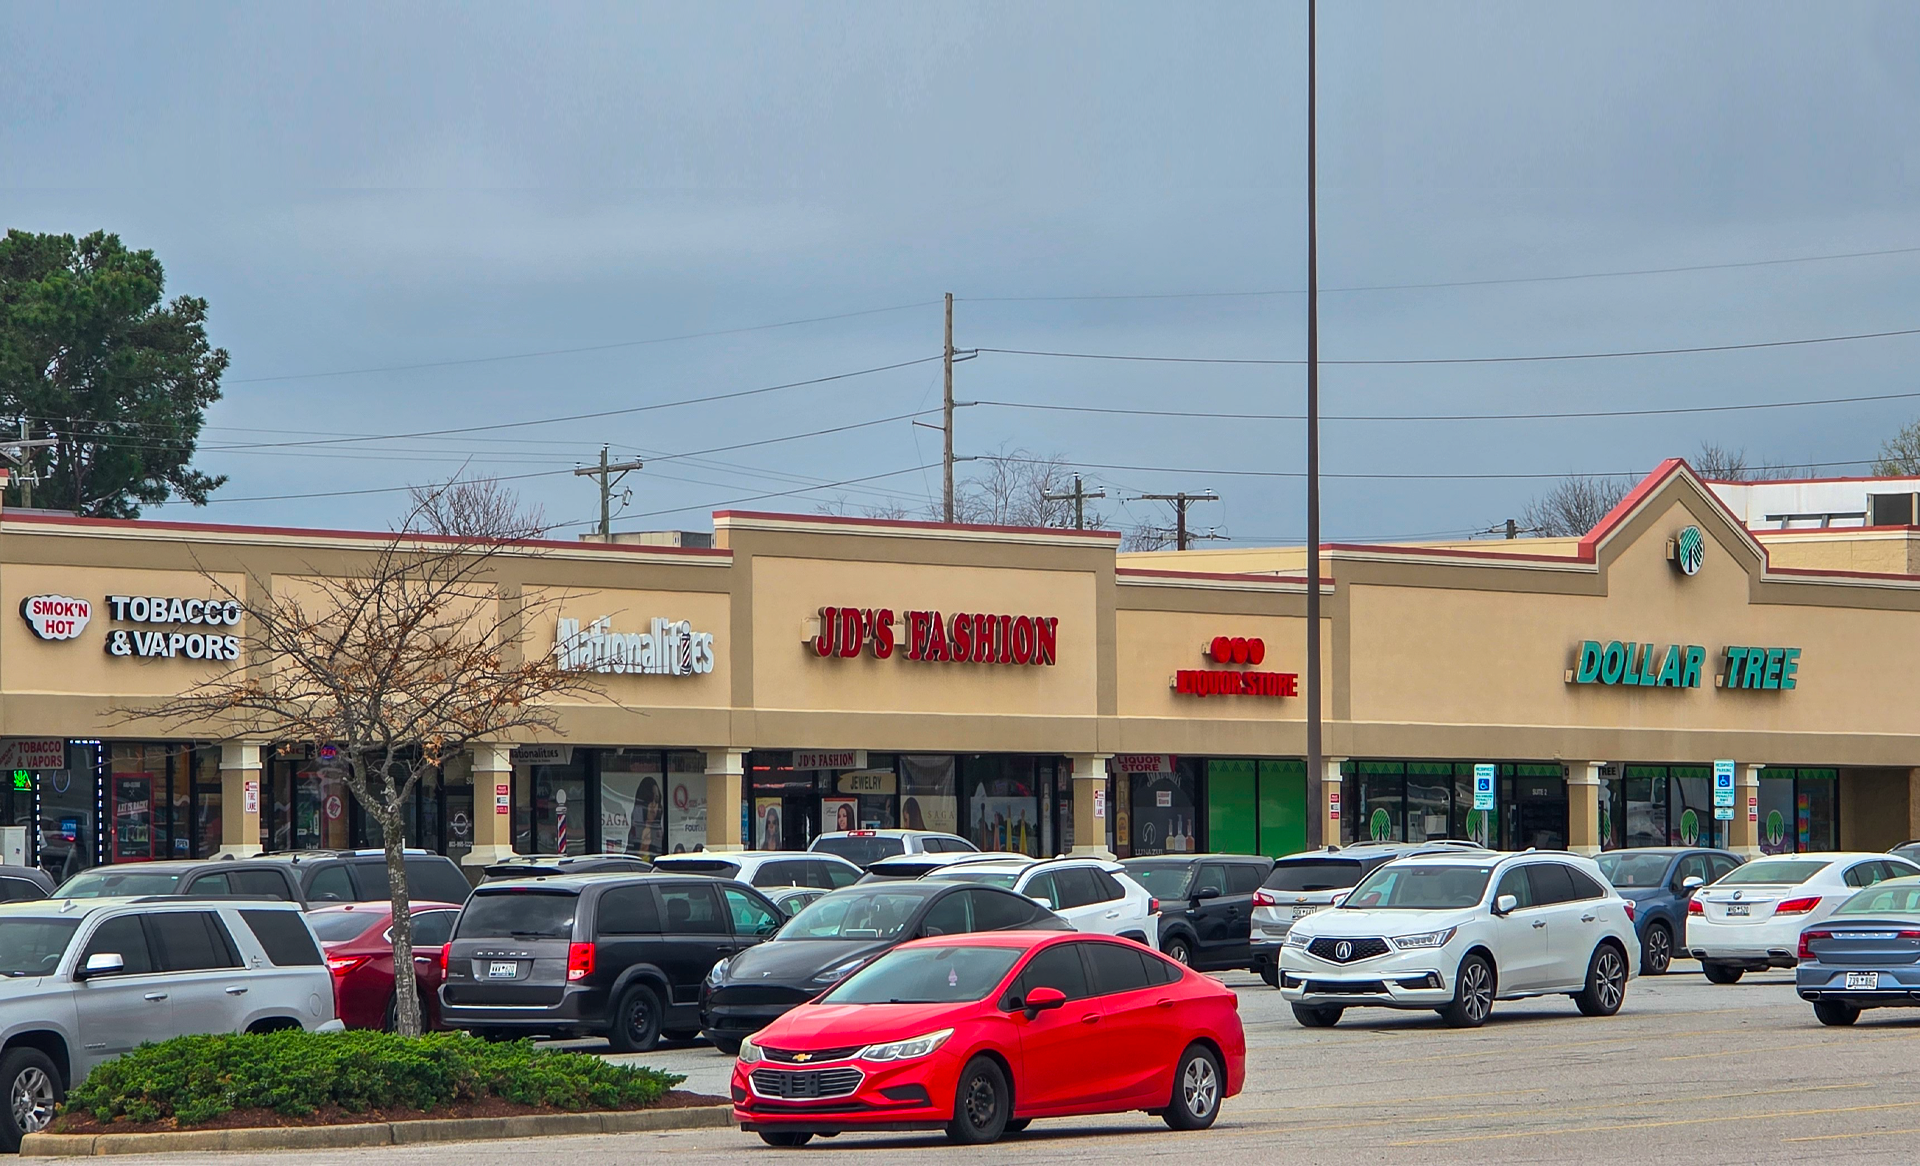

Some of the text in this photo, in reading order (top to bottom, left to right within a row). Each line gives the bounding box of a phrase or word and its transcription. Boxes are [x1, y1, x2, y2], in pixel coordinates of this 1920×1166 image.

[33, 600, 88, 618] SMOK'N
[107, 595, 243, 627] TOBACCO
[45, 619, 75, 635] HOT
[811, 606, 1060, 666] JD'S FASHION
[106, 629, 241, 661] & VAPORS
[1575, 640, 1802, 690] DOLLAR TREE
[1177, 670, 1299, 698] LIQUOR STORE
[18, 741, 62, 754] TOBACCO
[16, 755, 63, 768] & VAPORS
[797, 752, 854, 767] JD'S FASHION
[1117, 756, 1162, 765] LIQUOR
[1121, 763, 1160, 772] STORE
[1601, 766, 1617, 776] REE
[850, 775, 882, 790] JEWELRY
[927, 810, 955, 820] SAGA
